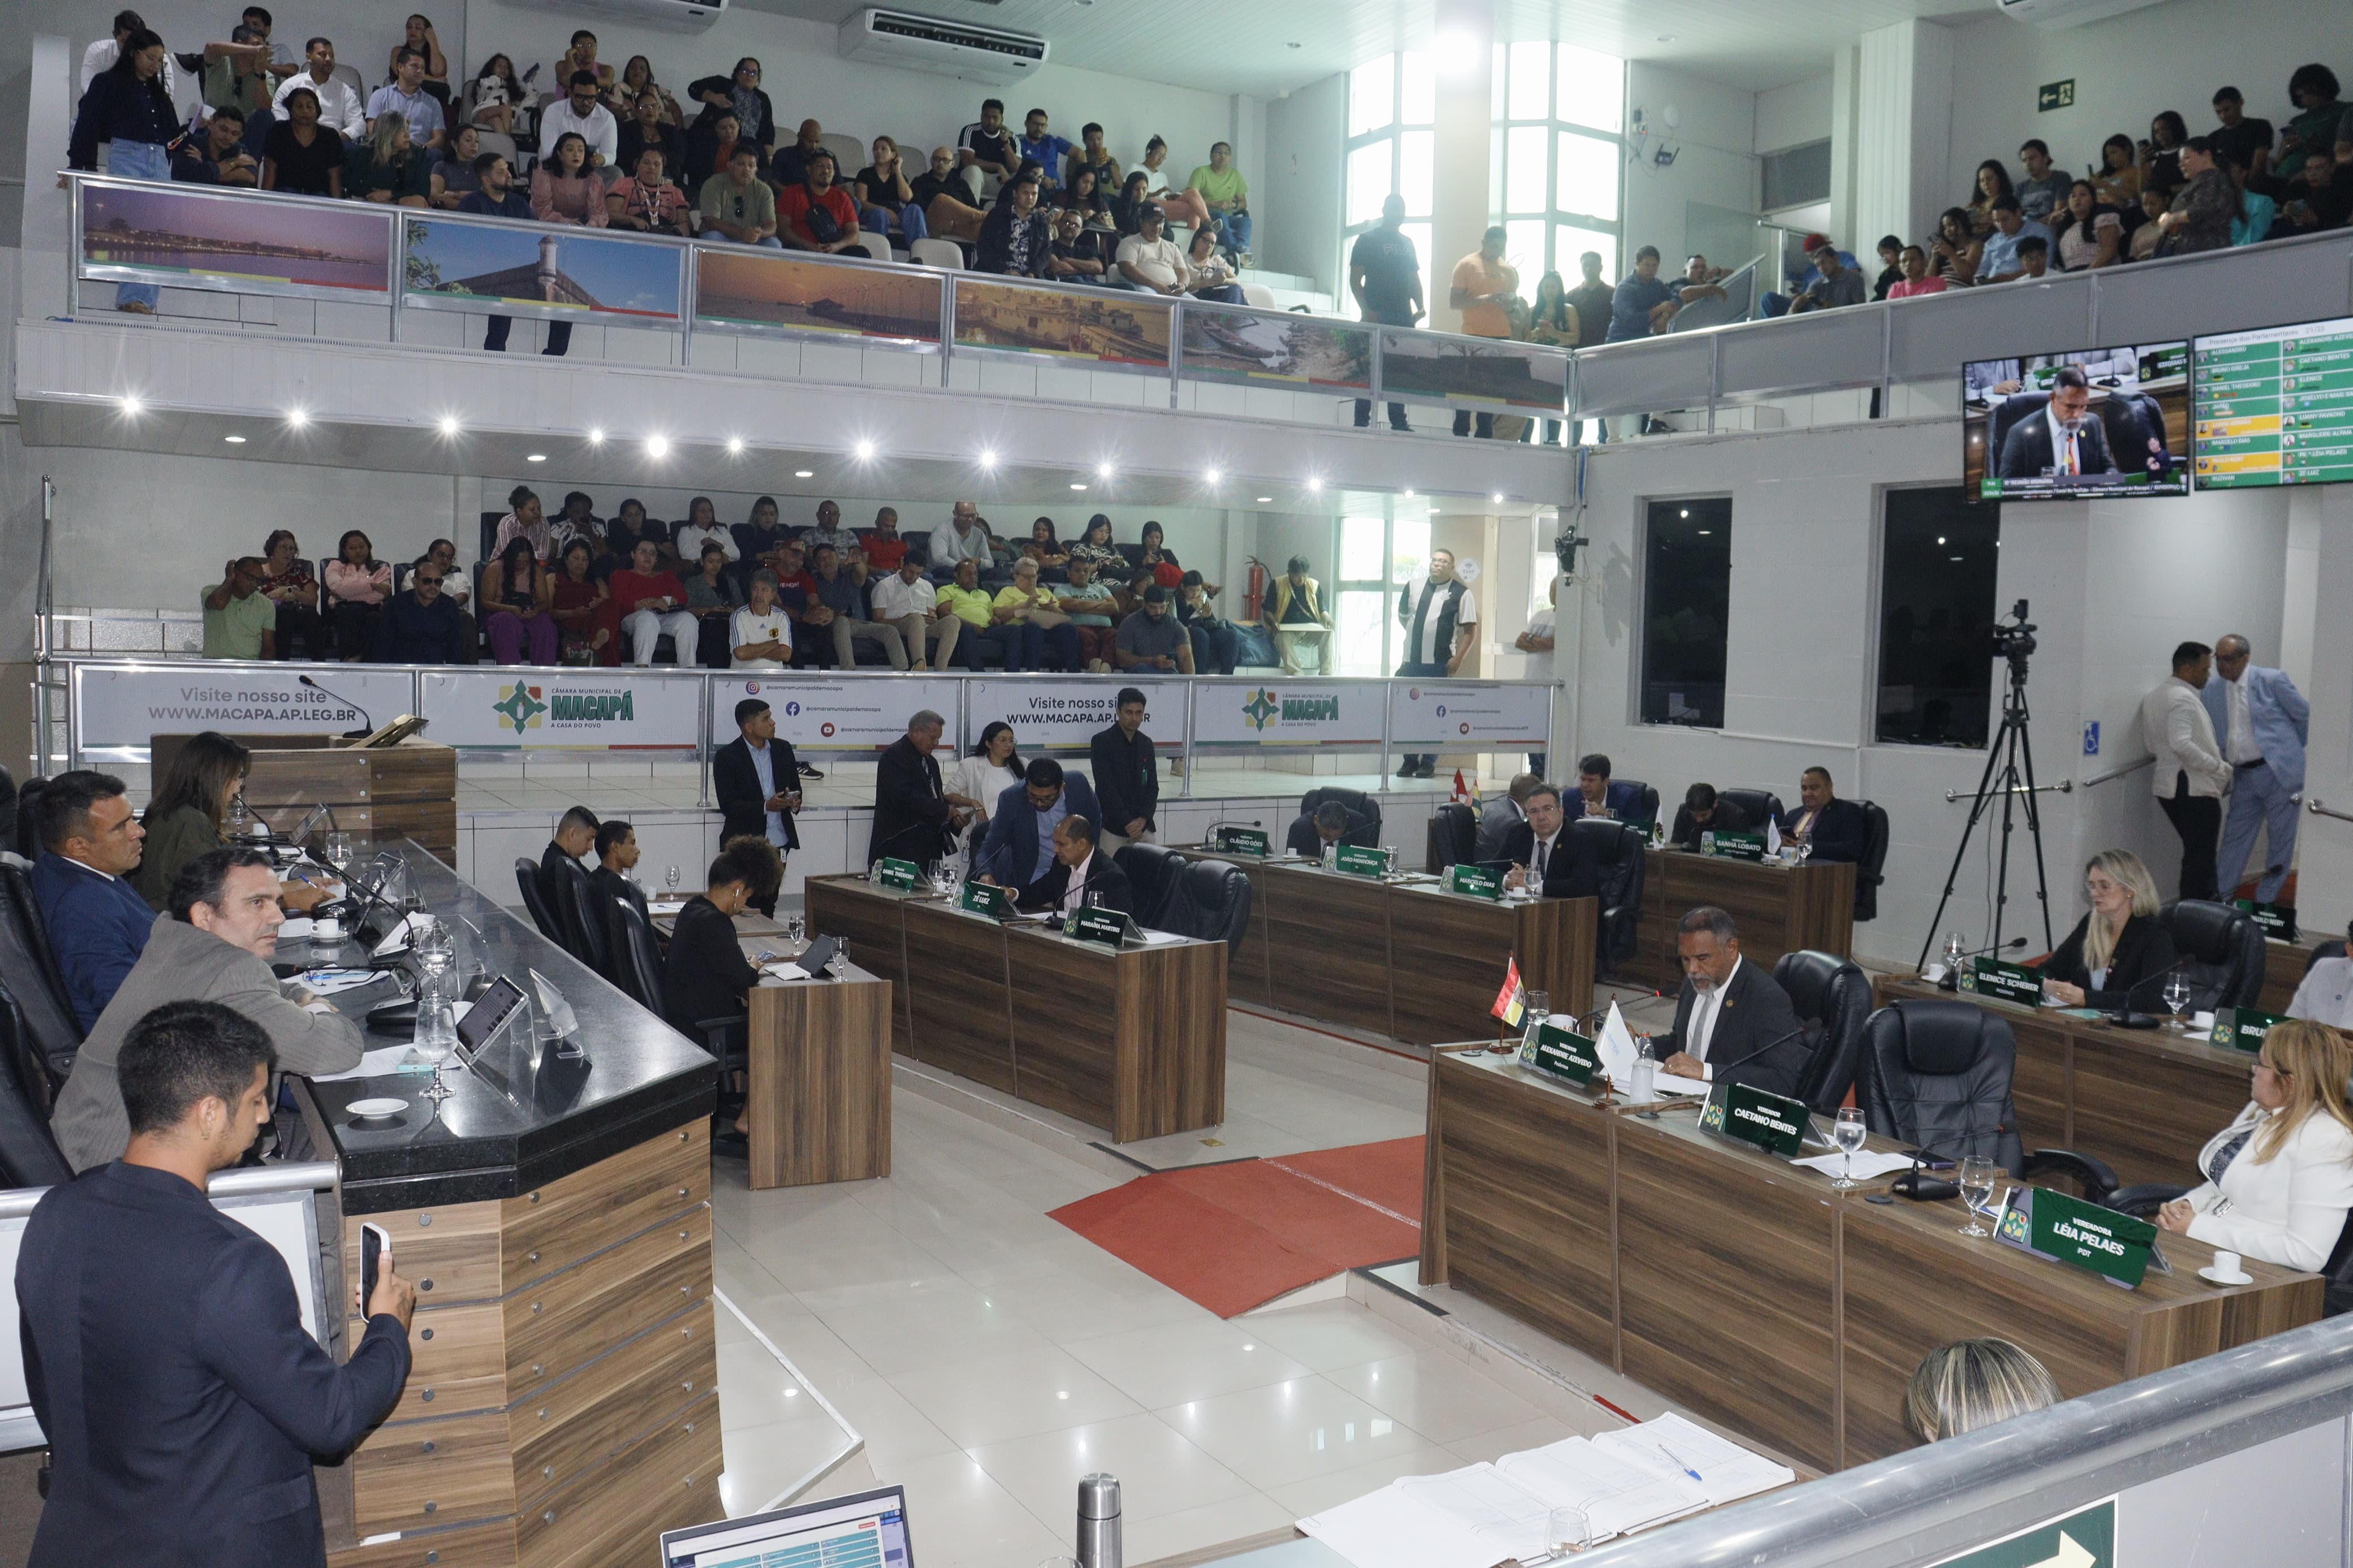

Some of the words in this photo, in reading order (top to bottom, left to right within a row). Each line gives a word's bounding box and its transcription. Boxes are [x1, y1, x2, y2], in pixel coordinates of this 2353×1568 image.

[181, 688, 232, 702] Visite
[238, 690, 290, 703] nosso
[295, 688, 327, 703] site
[551, 690, 634, 721] MACAPÁ
[1029, 697, 1065, 709] Visite
[1069, 699, 1105, 709] nosso
[1108, 697, 1117, 708] si
[1282, 695, 1339, 720] MACAPÁ
[148, 707, 356, 721] WWW.MACAPA.AP.LEG.BR
[1230, 837, 1249, 845] CLÁUDIO
[1717, 840, 1737, 848] BANHA
[1738, 843, 1761, 852] LOBATO
[1353, 858, 1378, 866] MENDONÇA
[894, 871, 915, 880] THEODORO
[1459, 877, 1483, 886] MARCELO
[979, 896, 990, 905] LUIZ
[1080, 920, 1101, 929] MARAÍNA
[1101, 924, 1120, 933] MARTINS
[2269, 918, 2285, 927] NERY
[1979, 973, 2006, 984] ELENICE
[2006, 979, 2039, 992] SCHERER
[1540, 1044, 1569, 1060] ALEXANDRE
[1568, 1054, 1592, 1068] AZEVEDO
[1554, 1061, 1568, 1070] Podemos
[1757, 1105, 1781, 1118] VEREADOR
[1734, 1108, 1770, 1126] CAETANO
[1769, 1119, 1797, 1135] BENTES
[2072, 1217, 2112, 1237] VEREADORA
[2053, 1222, 2078, 1241] LÉIA
[2080, 1232, 2125, 1256] PELAES
[2077, 1247, 2092, 1258] PDT
